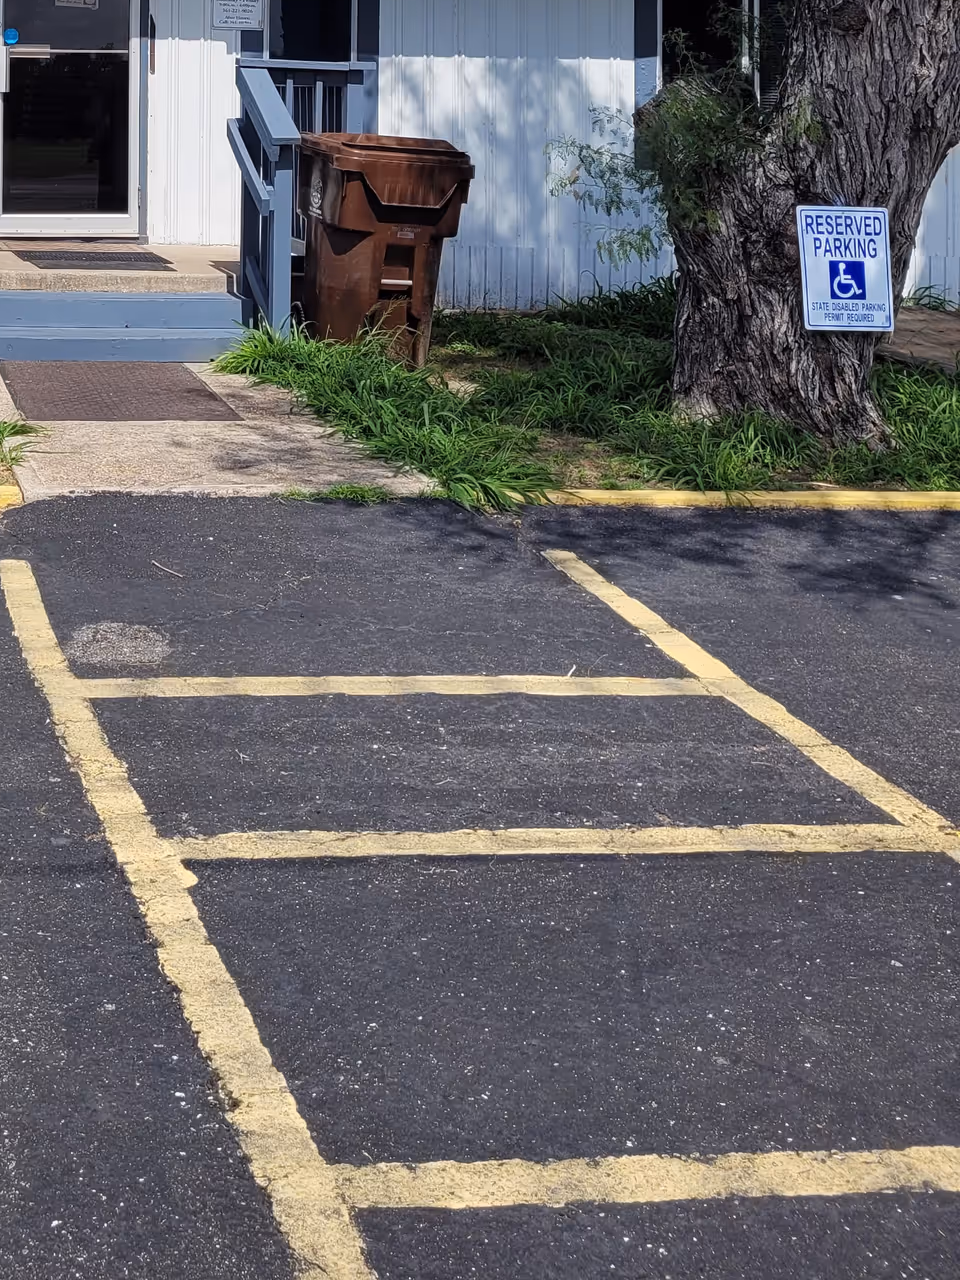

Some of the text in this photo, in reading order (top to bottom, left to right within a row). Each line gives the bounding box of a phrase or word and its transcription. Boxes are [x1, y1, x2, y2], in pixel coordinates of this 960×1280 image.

[805, 215, 882, 236] RESERVED
[813, 238, 877, 258] PARKING
[812, 302, 886, 312] STATE DISABLED PARKING
[824, 313, 874, 323] PERMIT REQUIRED
